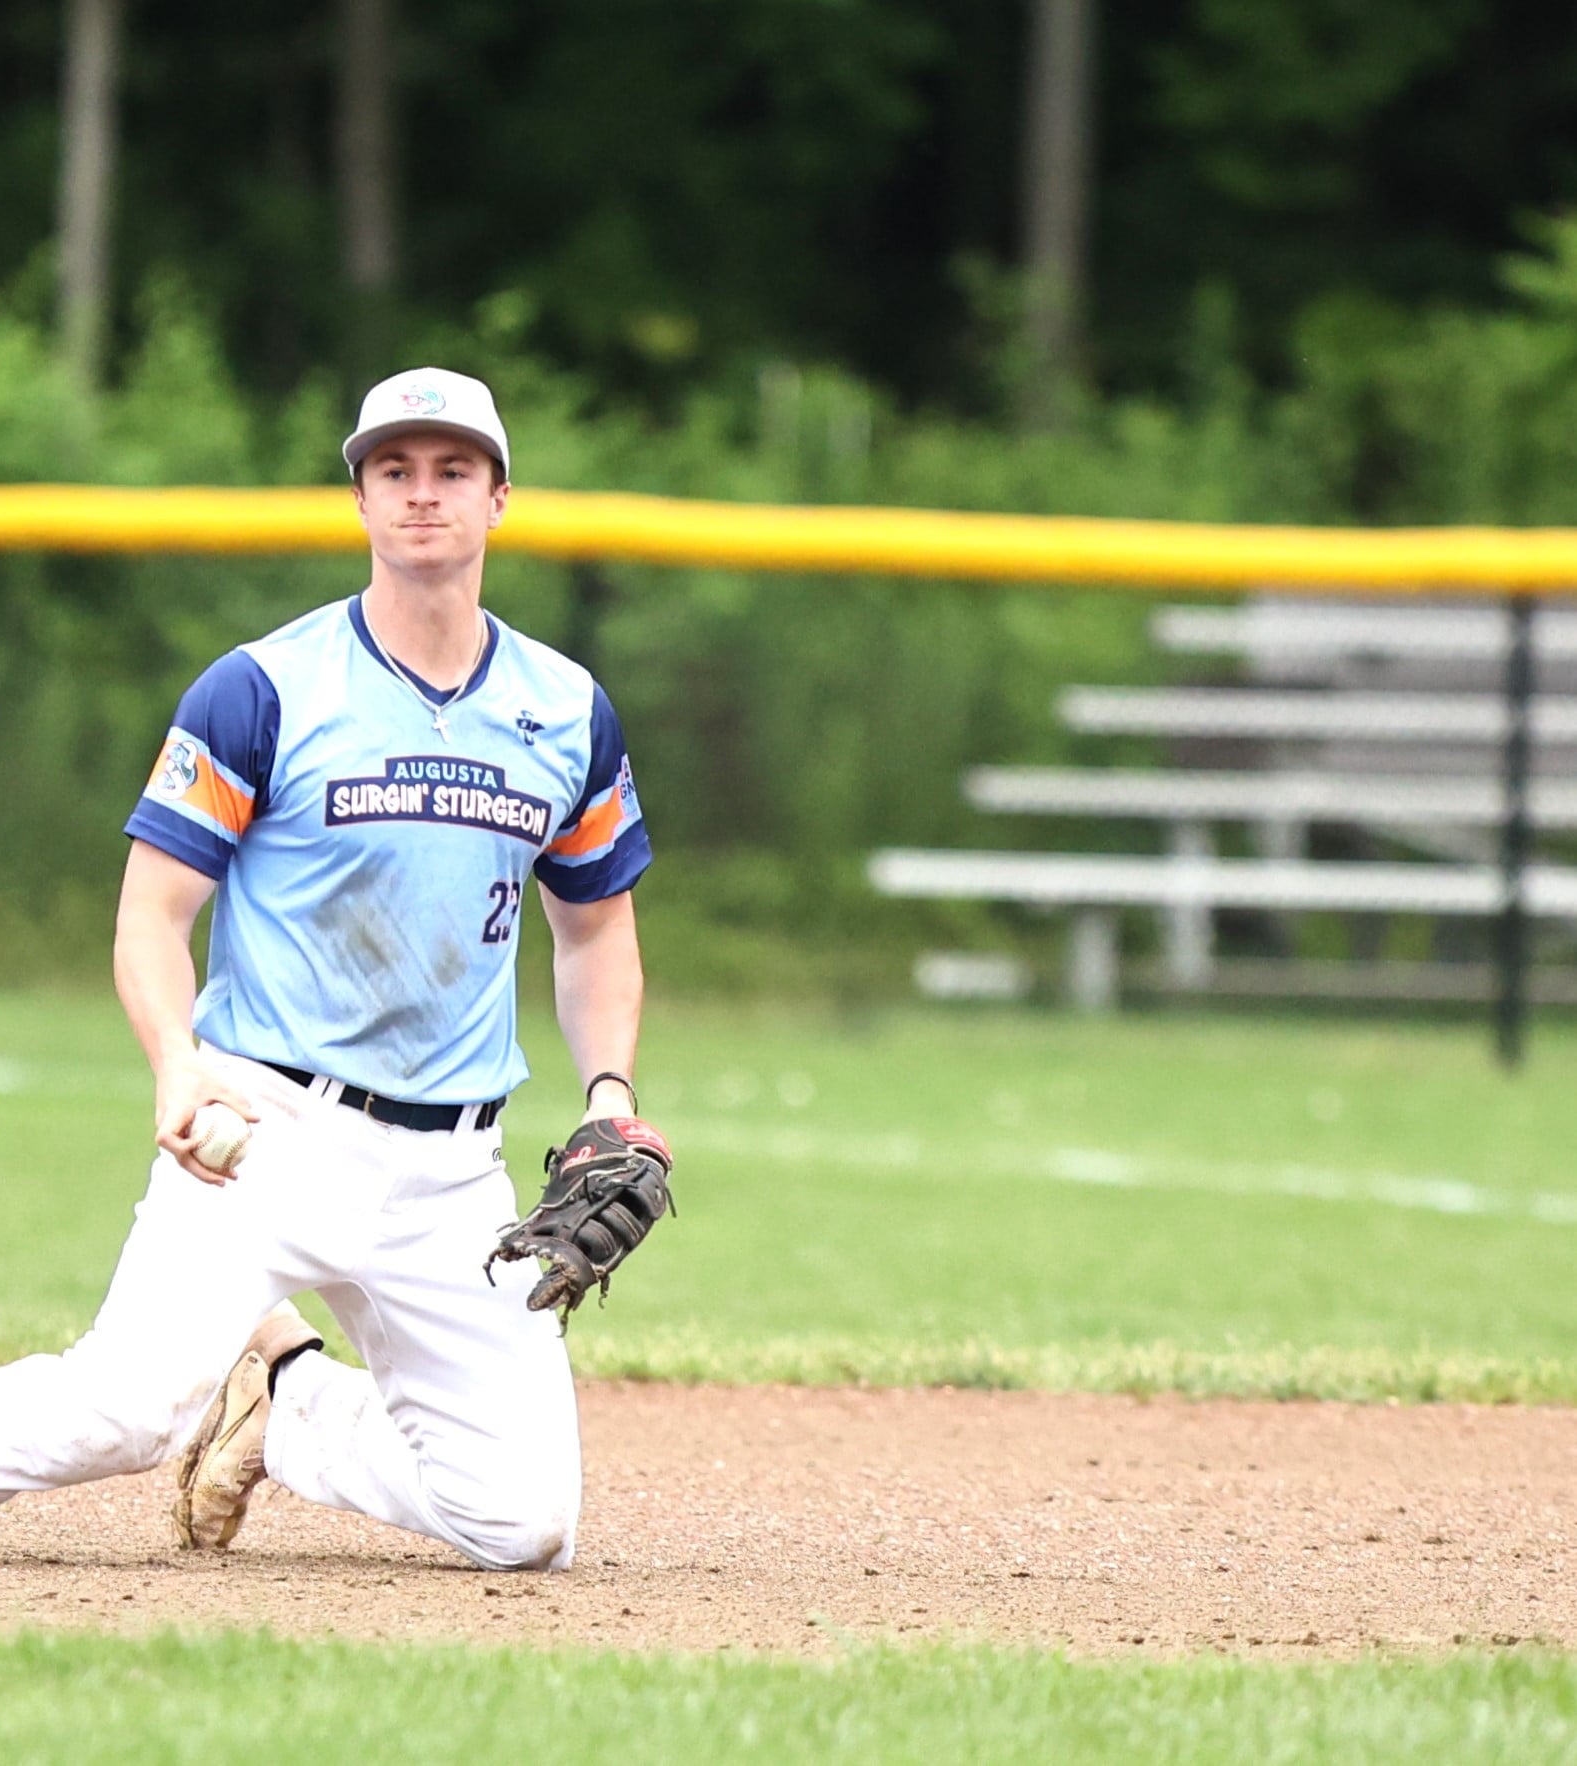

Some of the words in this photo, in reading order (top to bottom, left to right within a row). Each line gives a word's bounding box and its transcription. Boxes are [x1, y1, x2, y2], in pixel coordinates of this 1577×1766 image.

[393, 761, 498, 789] AUGUSTA
[332, 783, 430, 817] SURGIN'
[432, 787, 547, 837] STURGEON
